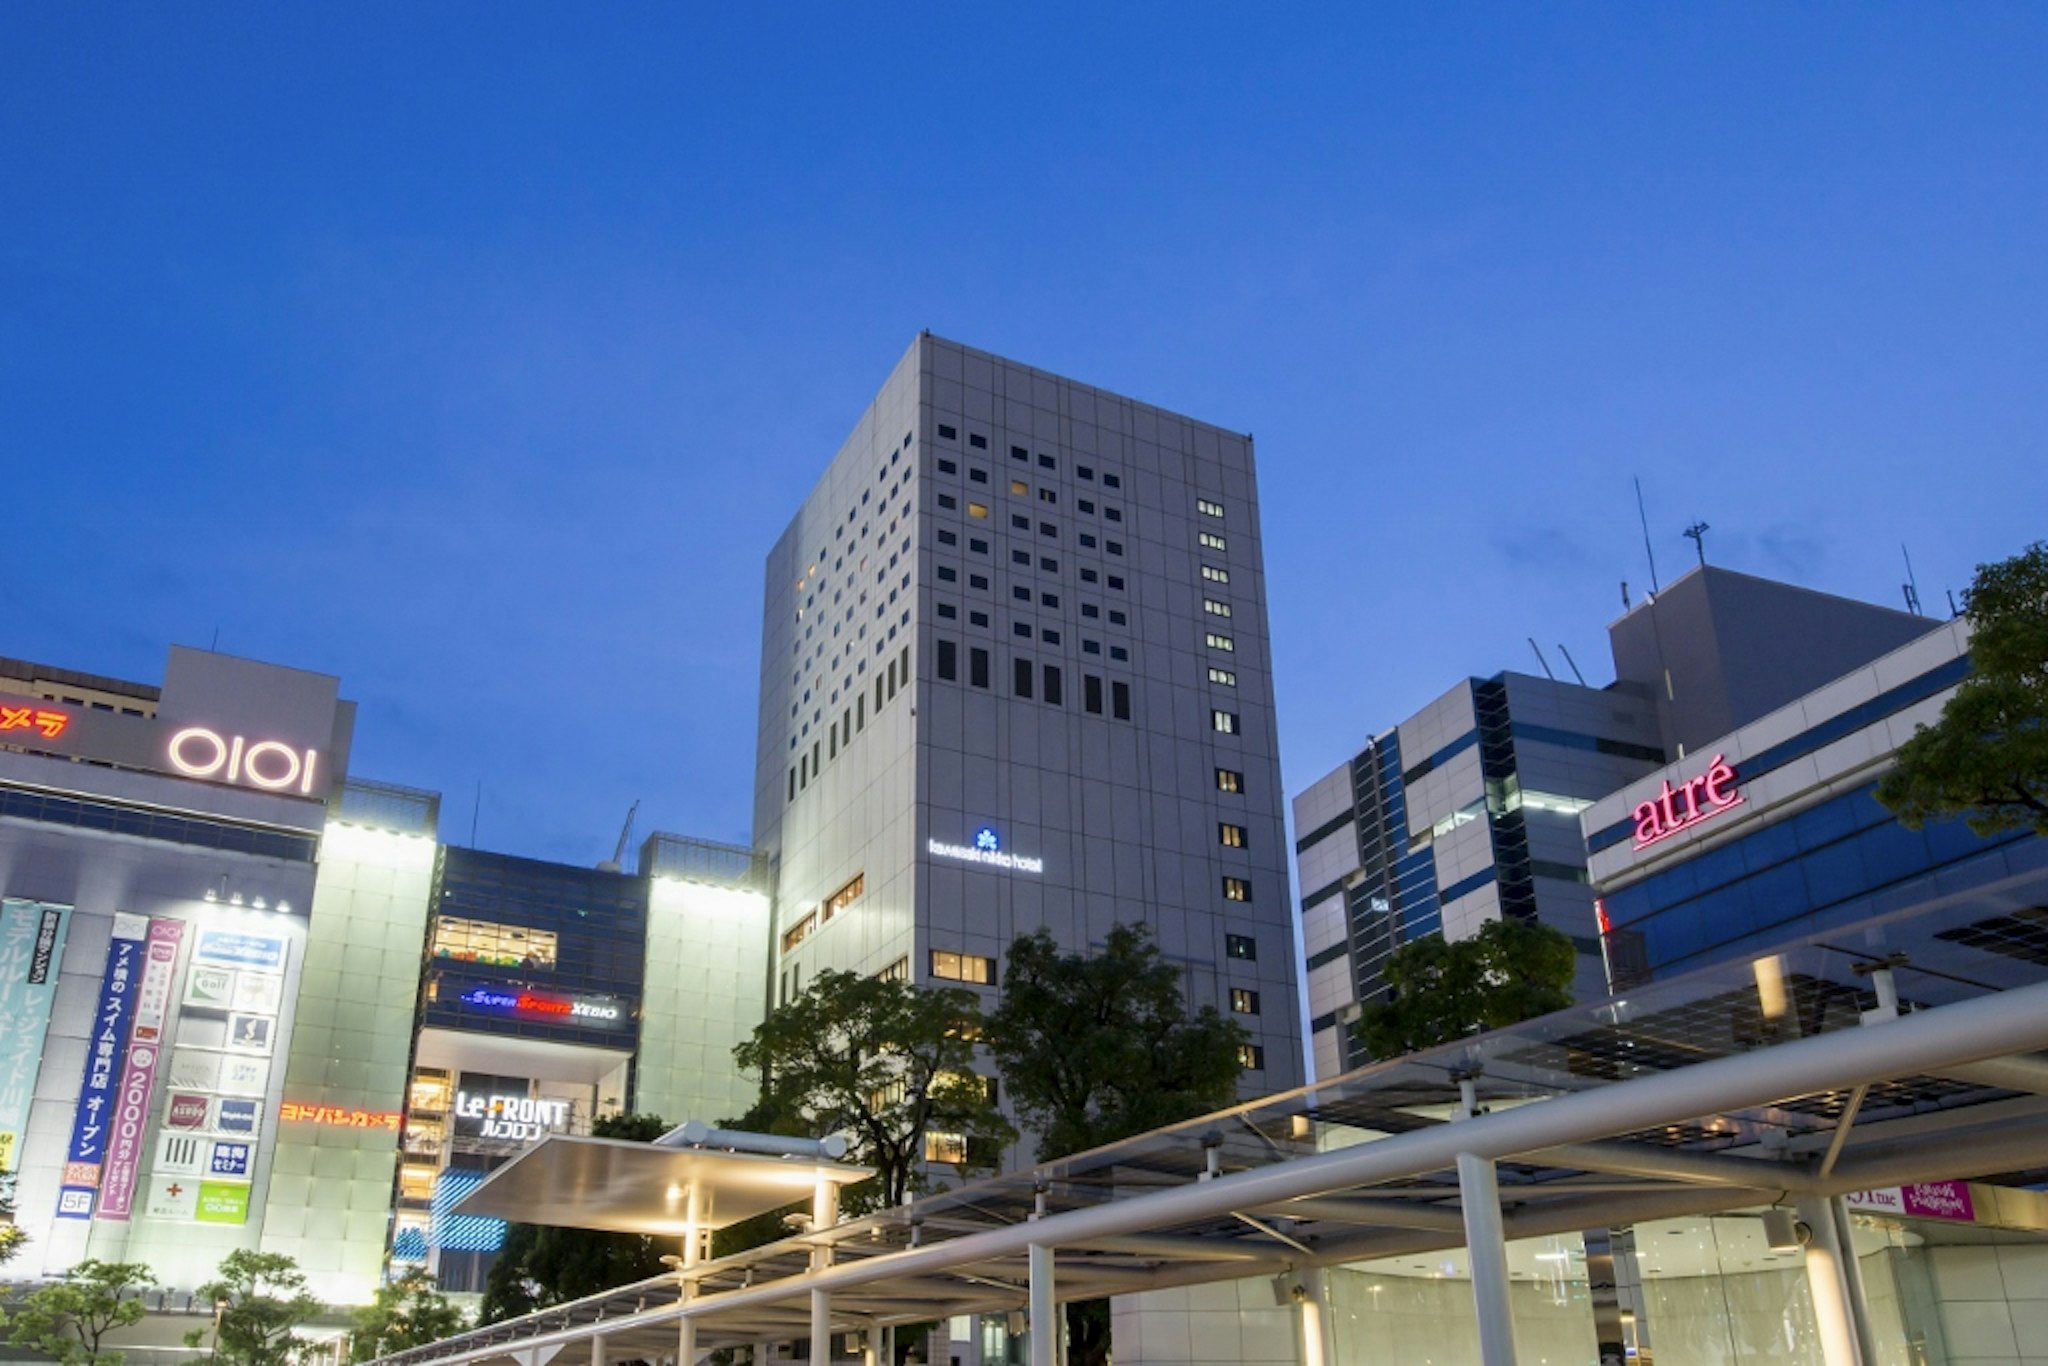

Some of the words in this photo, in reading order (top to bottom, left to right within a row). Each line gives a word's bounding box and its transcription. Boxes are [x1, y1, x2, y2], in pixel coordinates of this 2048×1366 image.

[1633, 753, 1741, 842] atré
[1012, 853, 1042, 873] hotel
[202, 978, 227, 991] Golf
[571, 1002, 618, 1020] XEBIO
[90, 996, 122, 1090] スイム専門店
[79, 1094, 105, 1157] オープン
[280, 1103, 402, 1131] ヨドバシカメラ
[213, 1158, 246, 1171] セミナー
[63, 1193, 90, 1210] 5F
